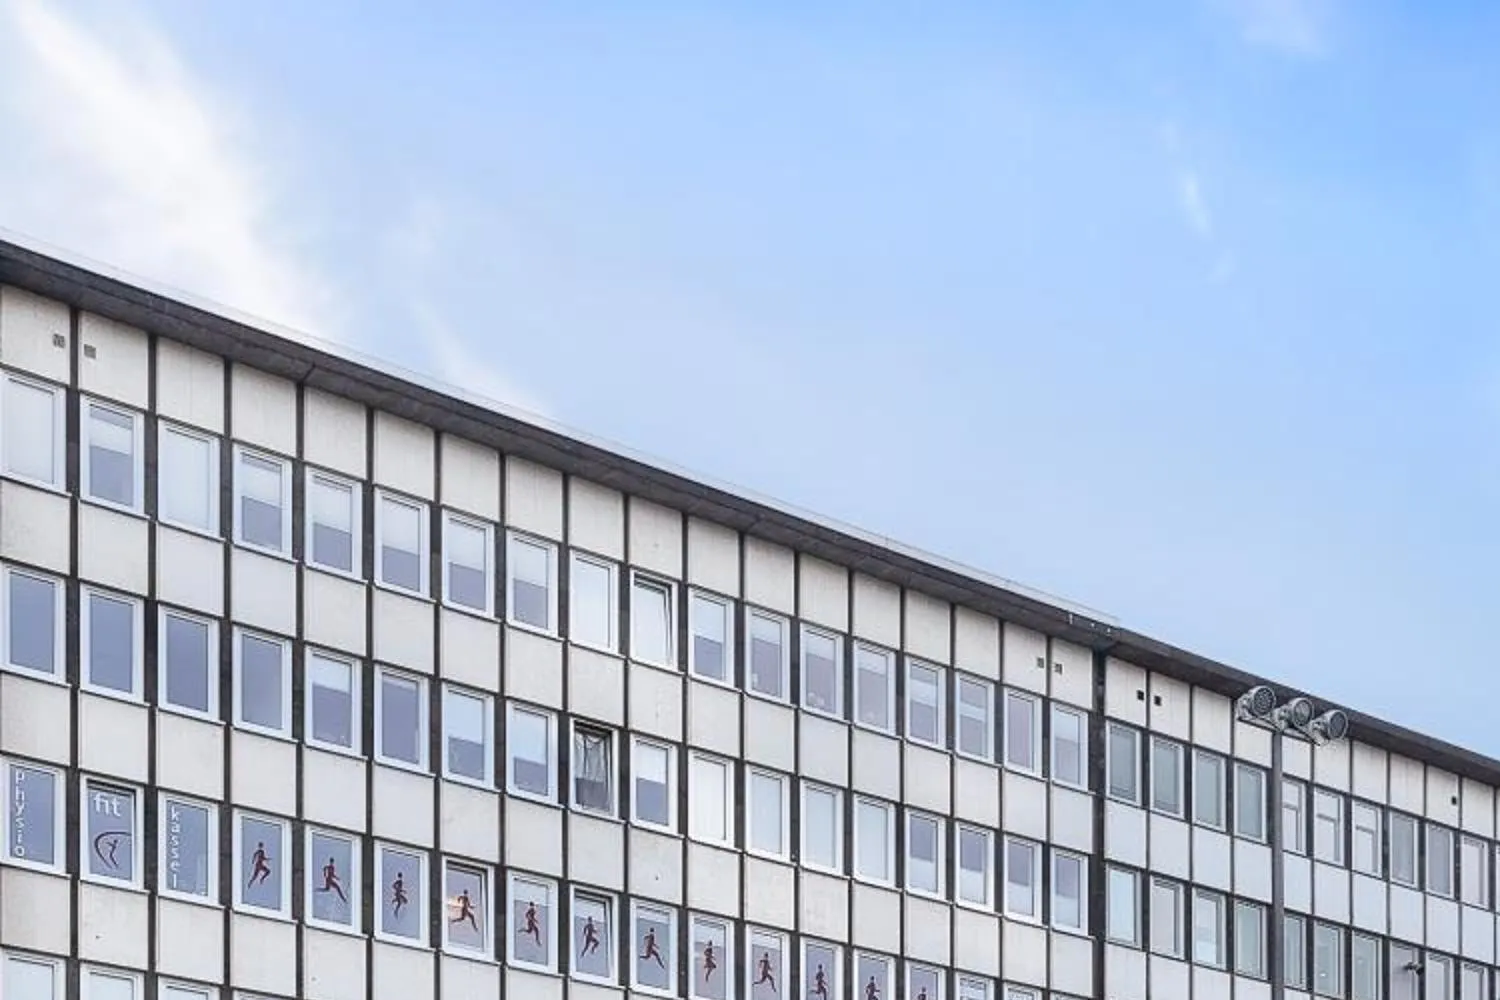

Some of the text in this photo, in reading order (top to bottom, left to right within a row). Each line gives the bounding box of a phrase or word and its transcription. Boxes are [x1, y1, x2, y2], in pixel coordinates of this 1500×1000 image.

[14, 768, 26, 857] physio
[94, 791, 122, 817] fit
[170, 805, 182, 888] kassel
